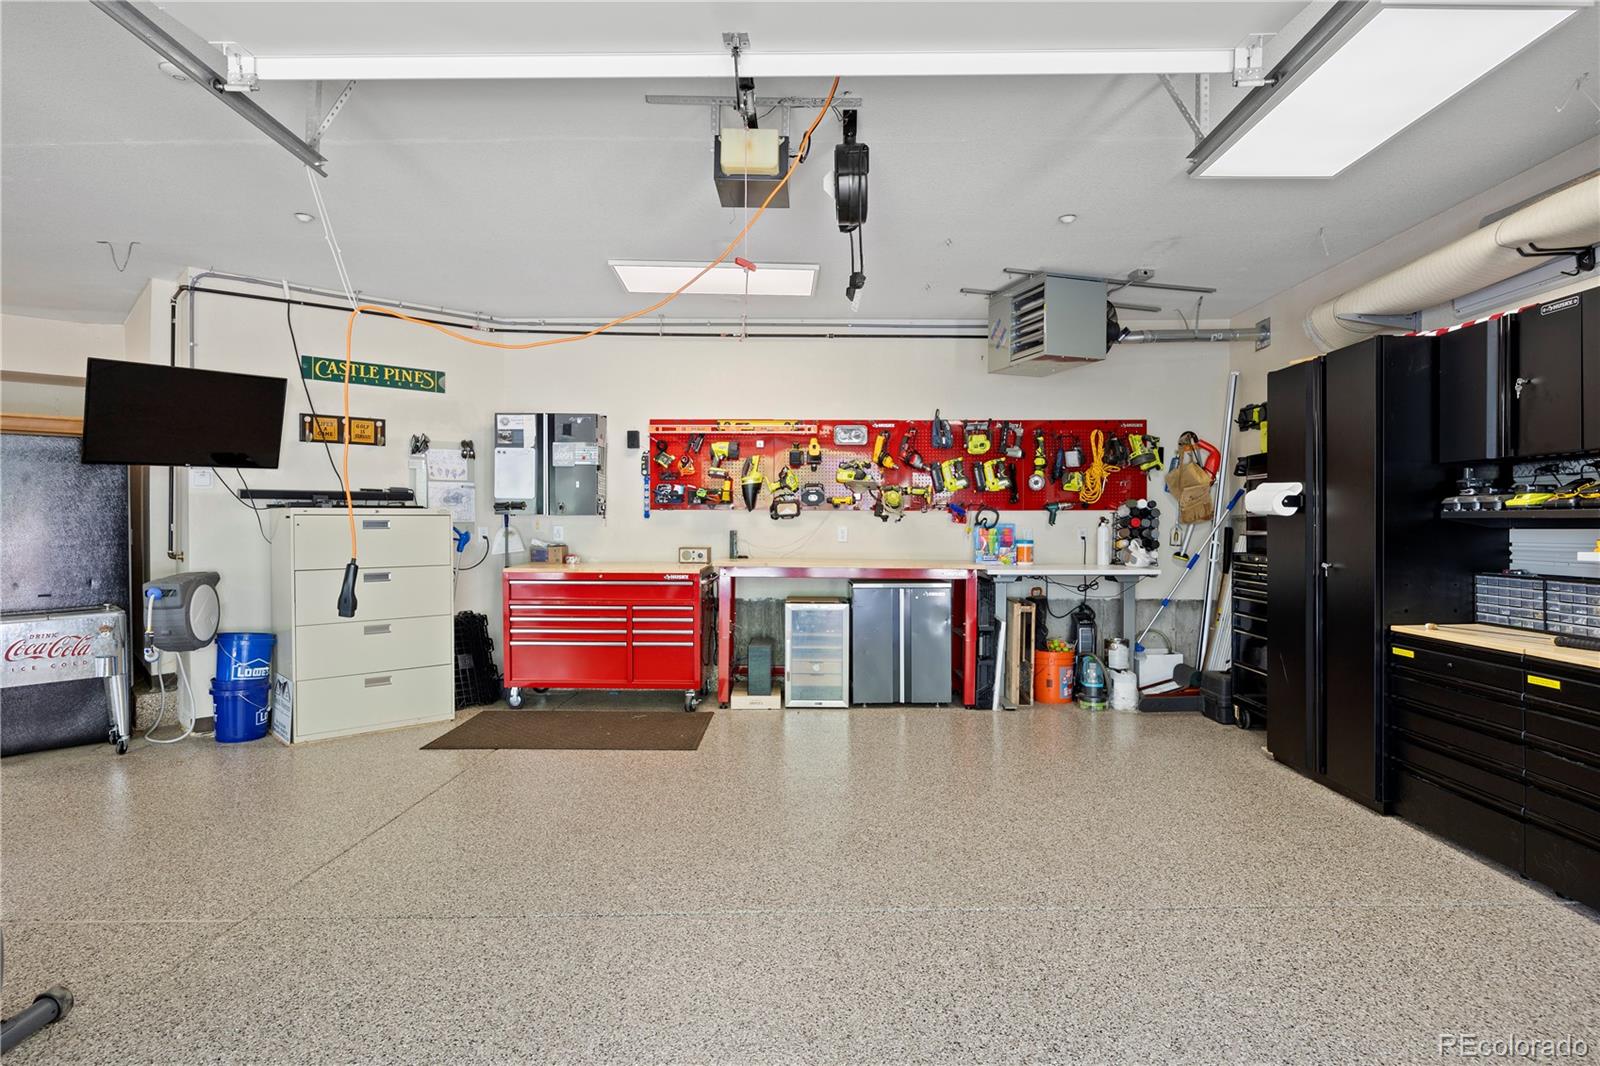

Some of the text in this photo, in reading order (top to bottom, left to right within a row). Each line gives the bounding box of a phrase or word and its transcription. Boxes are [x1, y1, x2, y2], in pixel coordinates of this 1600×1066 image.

[315, 359, 435, 389] CASTLE PINES
[29, 632, 59, 640] DRINK
[4, 634, 95, 662] Coca-Cola
[11, 660, 88, 673] ICE COLD
